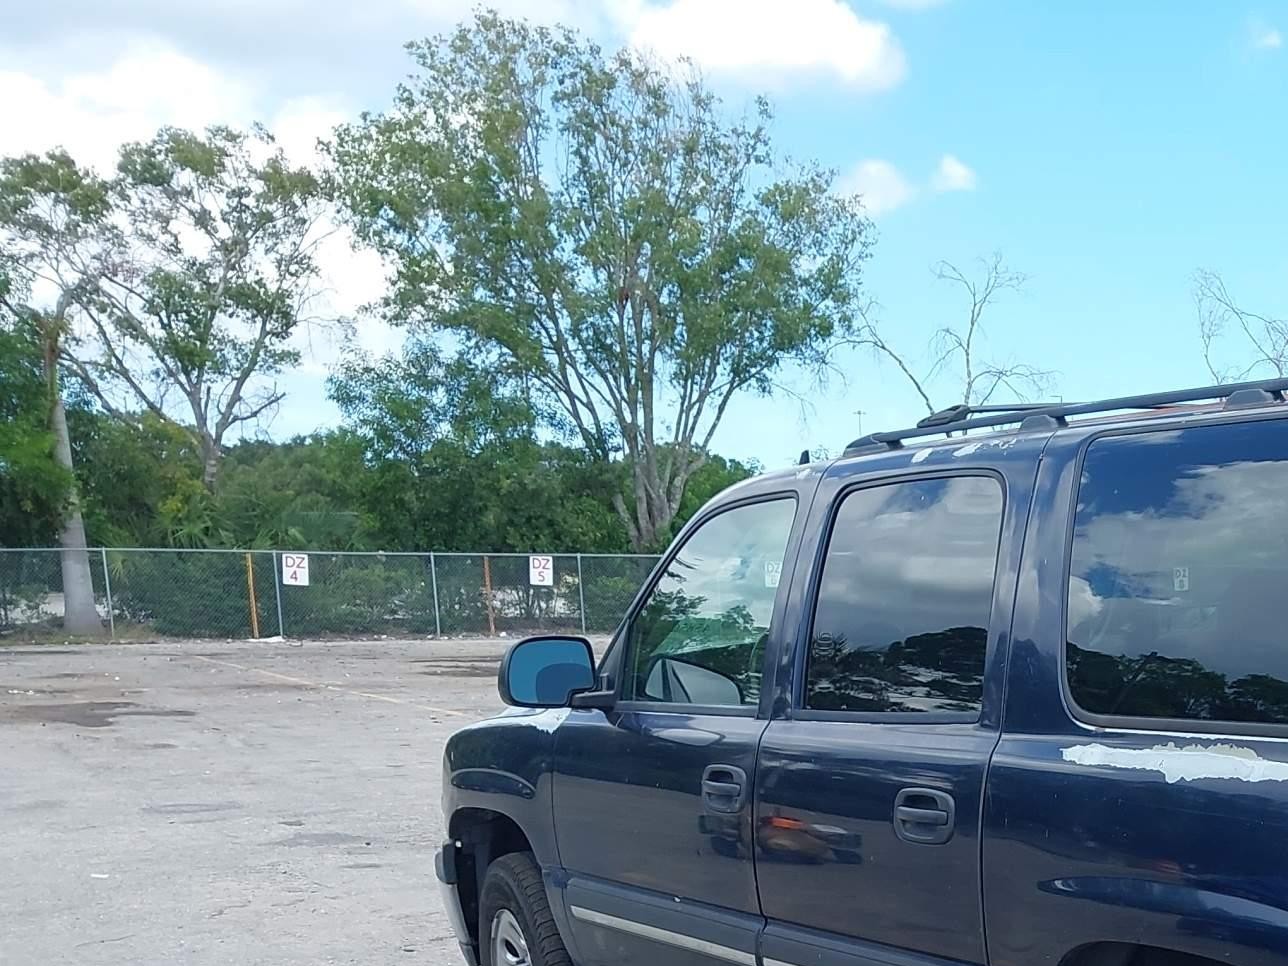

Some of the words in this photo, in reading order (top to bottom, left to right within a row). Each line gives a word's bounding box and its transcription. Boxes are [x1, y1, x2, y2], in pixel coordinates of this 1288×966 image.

[285, 556, 306, 569] DZ
[532, 558, 551, 570] DZ
[290, 570, 298, 582] 4
[538, 571, 545, 582] 5
